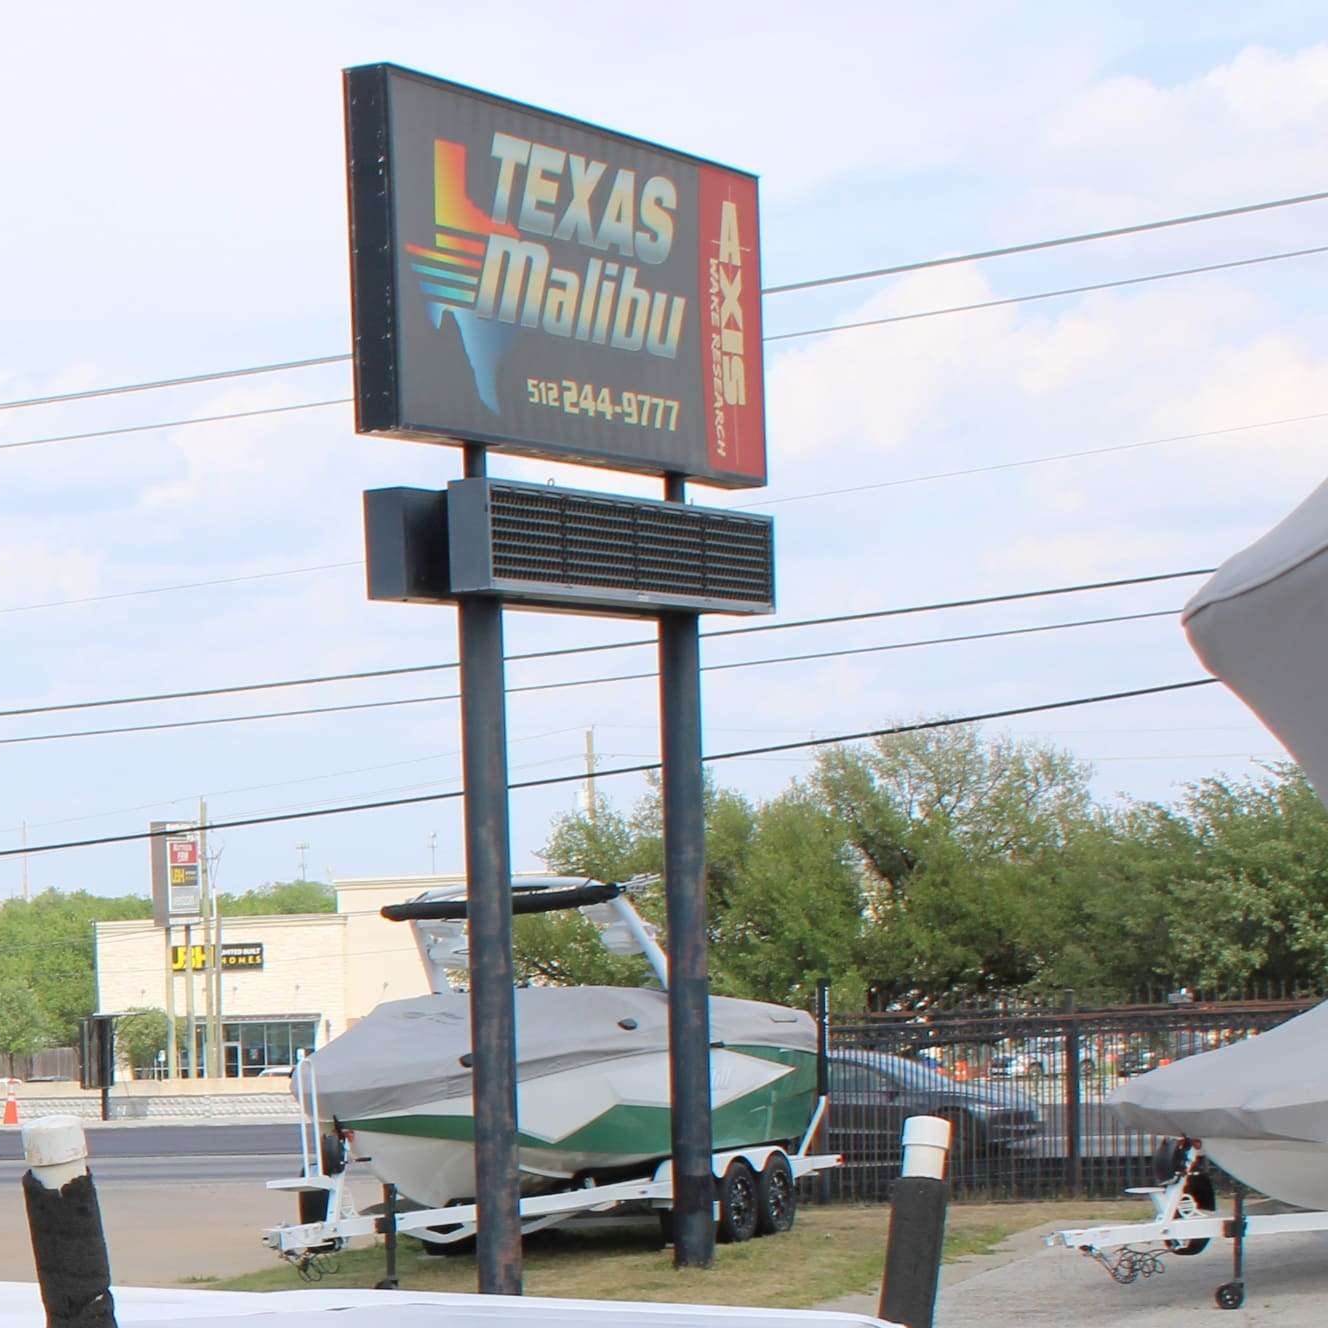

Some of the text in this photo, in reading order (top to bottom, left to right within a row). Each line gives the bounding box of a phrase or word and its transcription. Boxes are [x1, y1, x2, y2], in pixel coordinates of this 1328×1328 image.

[491, 132, 677, 264] TEXAS
[476, 234, 686, 359] Malibu
[710, 258, 726, 457] WAKE RESEARCH
[718, 200, 746, 406] AXIS
[527, 378, 680, 432] 512 244-9777
